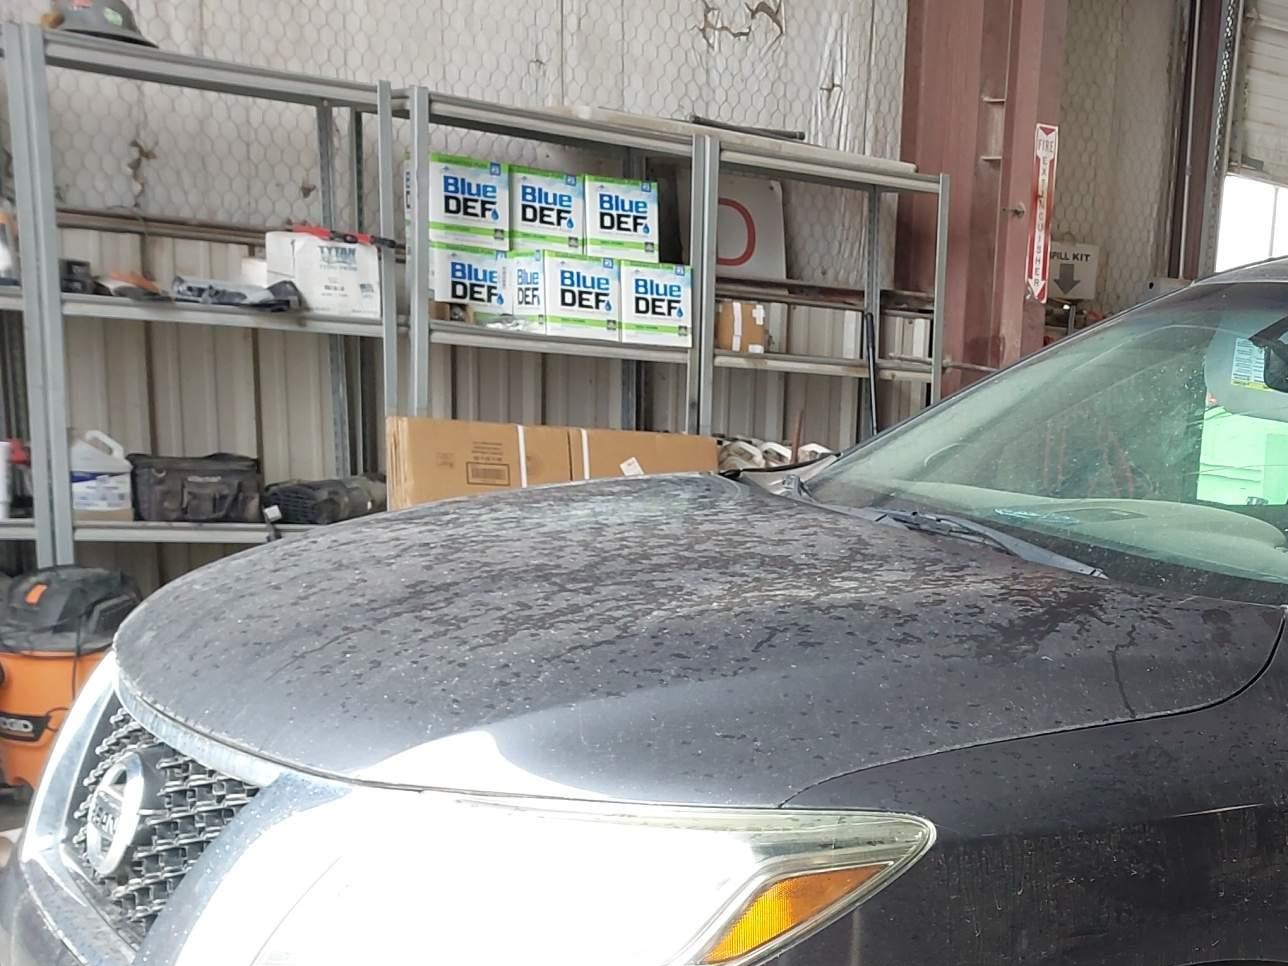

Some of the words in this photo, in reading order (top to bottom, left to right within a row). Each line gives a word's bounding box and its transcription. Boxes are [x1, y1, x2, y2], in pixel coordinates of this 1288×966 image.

[443, 175, 497, 199] Blue
[521, 184, 572, 208] Blue
[444, 195, 497, 218] DEF
[599, 193, 648, 214] Blue
[521, 203, 572, 227] DEF
[599, 211, 648, 233] DEF
[1072, 252, 1091, 262] KIT
[450, 261, 498, 283] Blue
[516, 269, 539, 285] Blue
[560, 269, 610, 291] Blue
[451, 280, 498, 303] DEF
[517, 287, 540, 305] DEF
[560, 288, 610, 310] DEF
[634, 278, 682, 298] Blue
[634, 296, 681, 317] DEF
